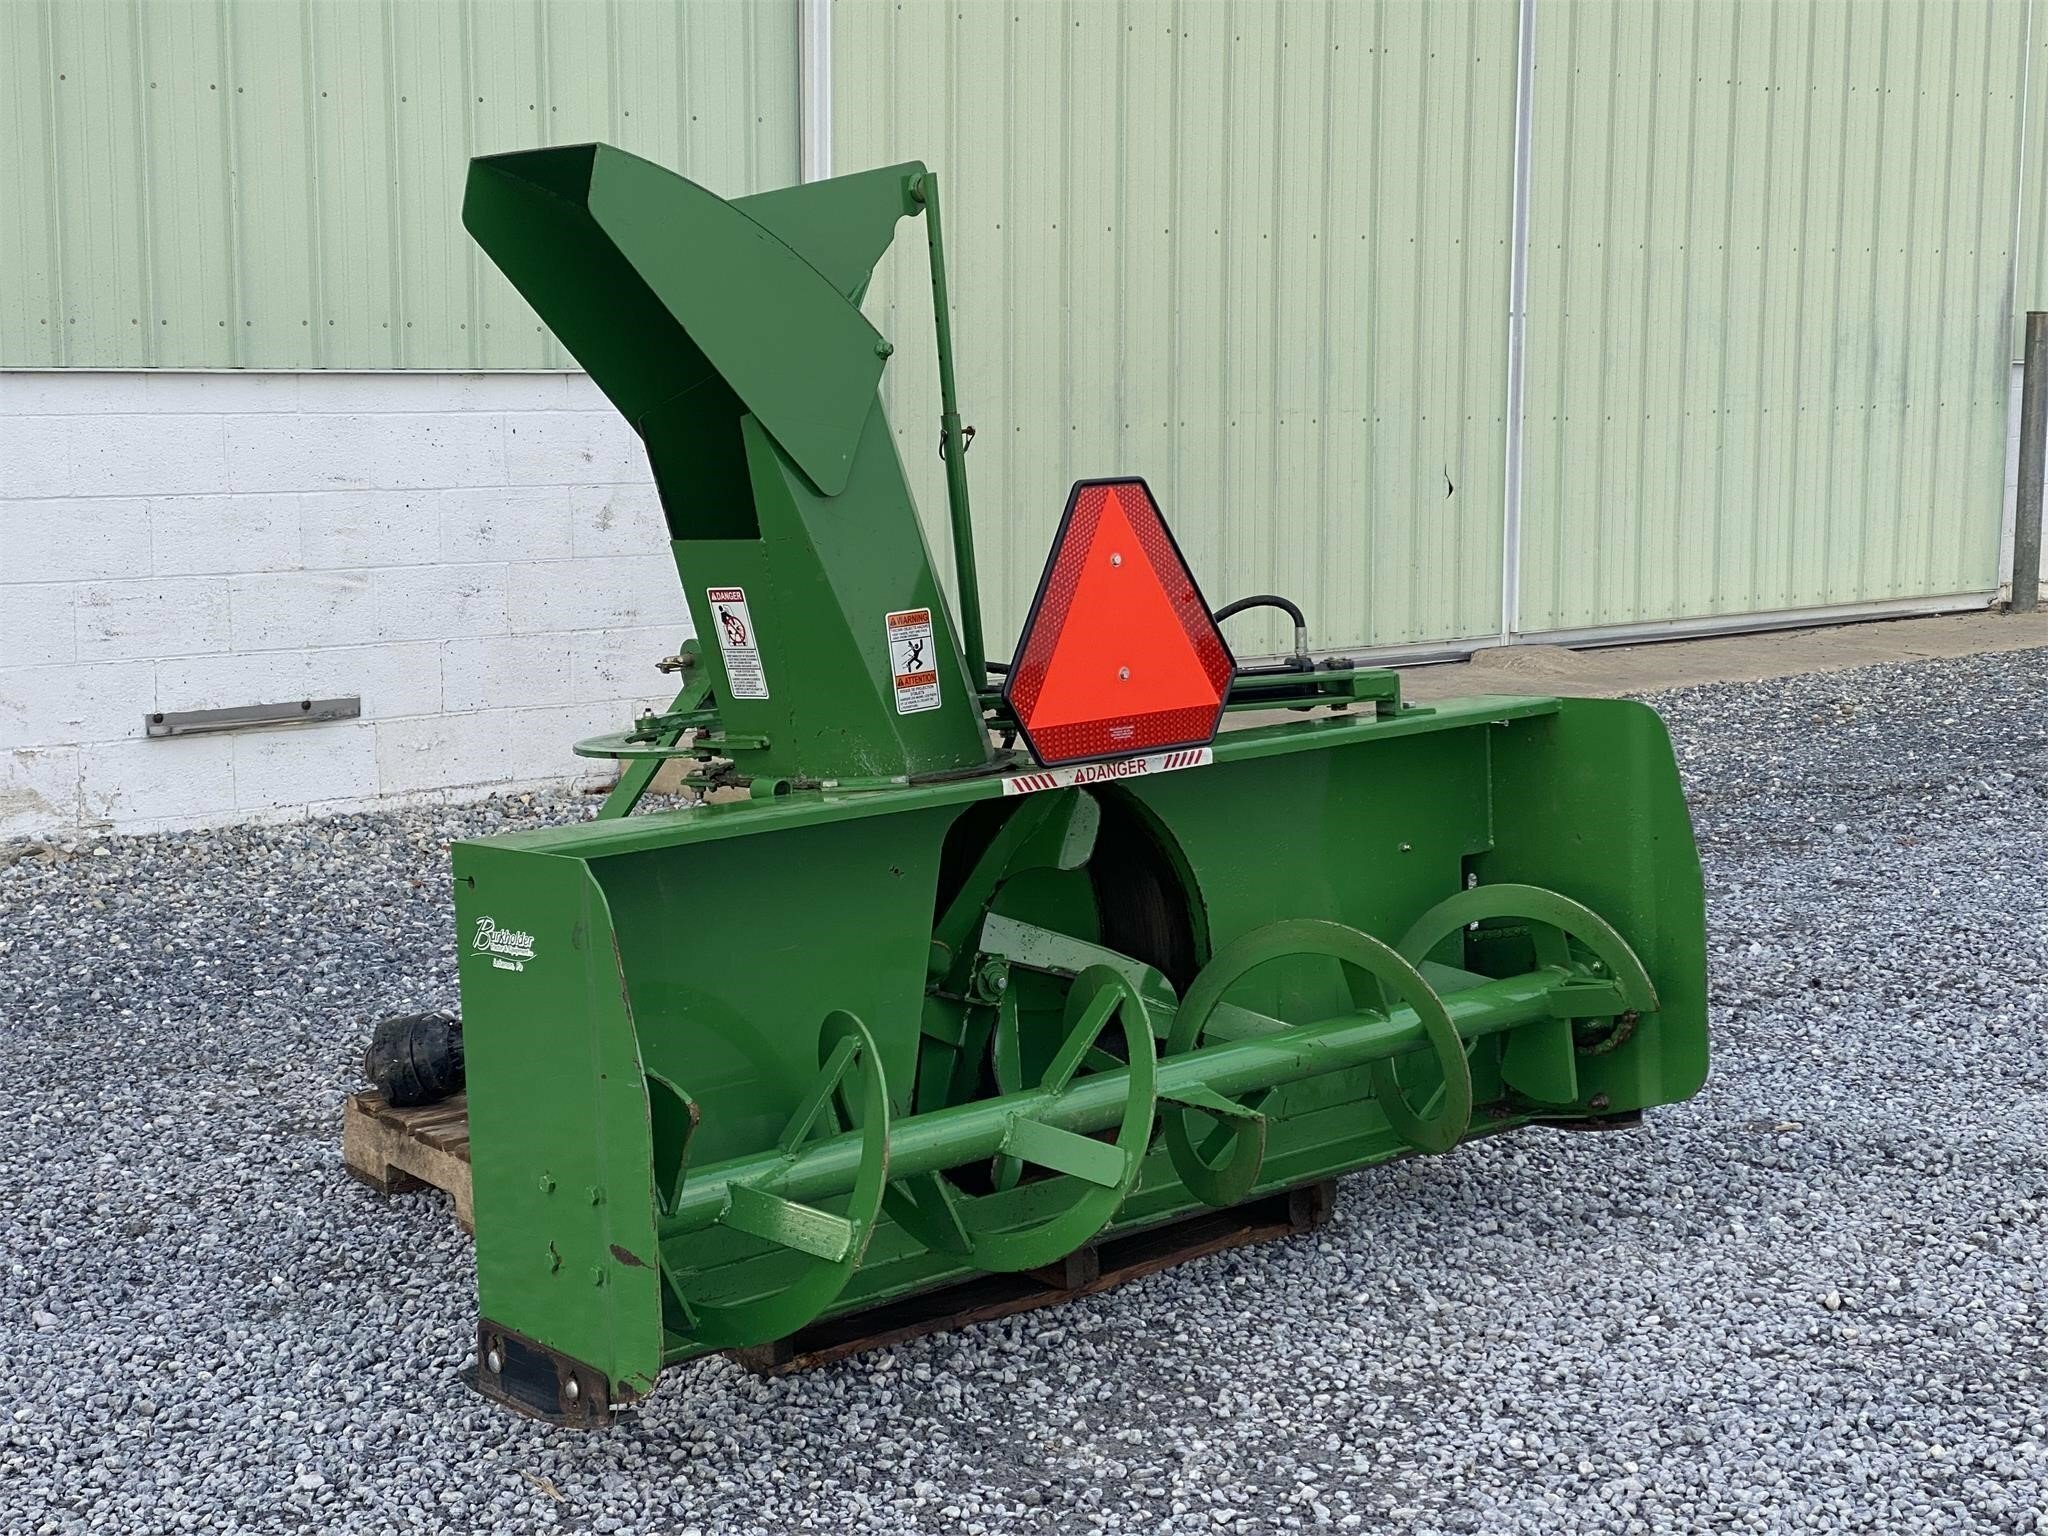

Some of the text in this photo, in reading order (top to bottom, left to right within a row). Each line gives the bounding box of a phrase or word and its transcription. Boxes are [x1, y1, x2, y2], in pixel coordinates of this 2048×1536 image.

[715, 591, 742, 600] DANGER
[897, 612, 928, 625] WARNING
[904, 672, 935, 685] ATTENTION
[1086, 759, 1147, 782] DANGER
[473, 916, 534, 950] Burkholder
